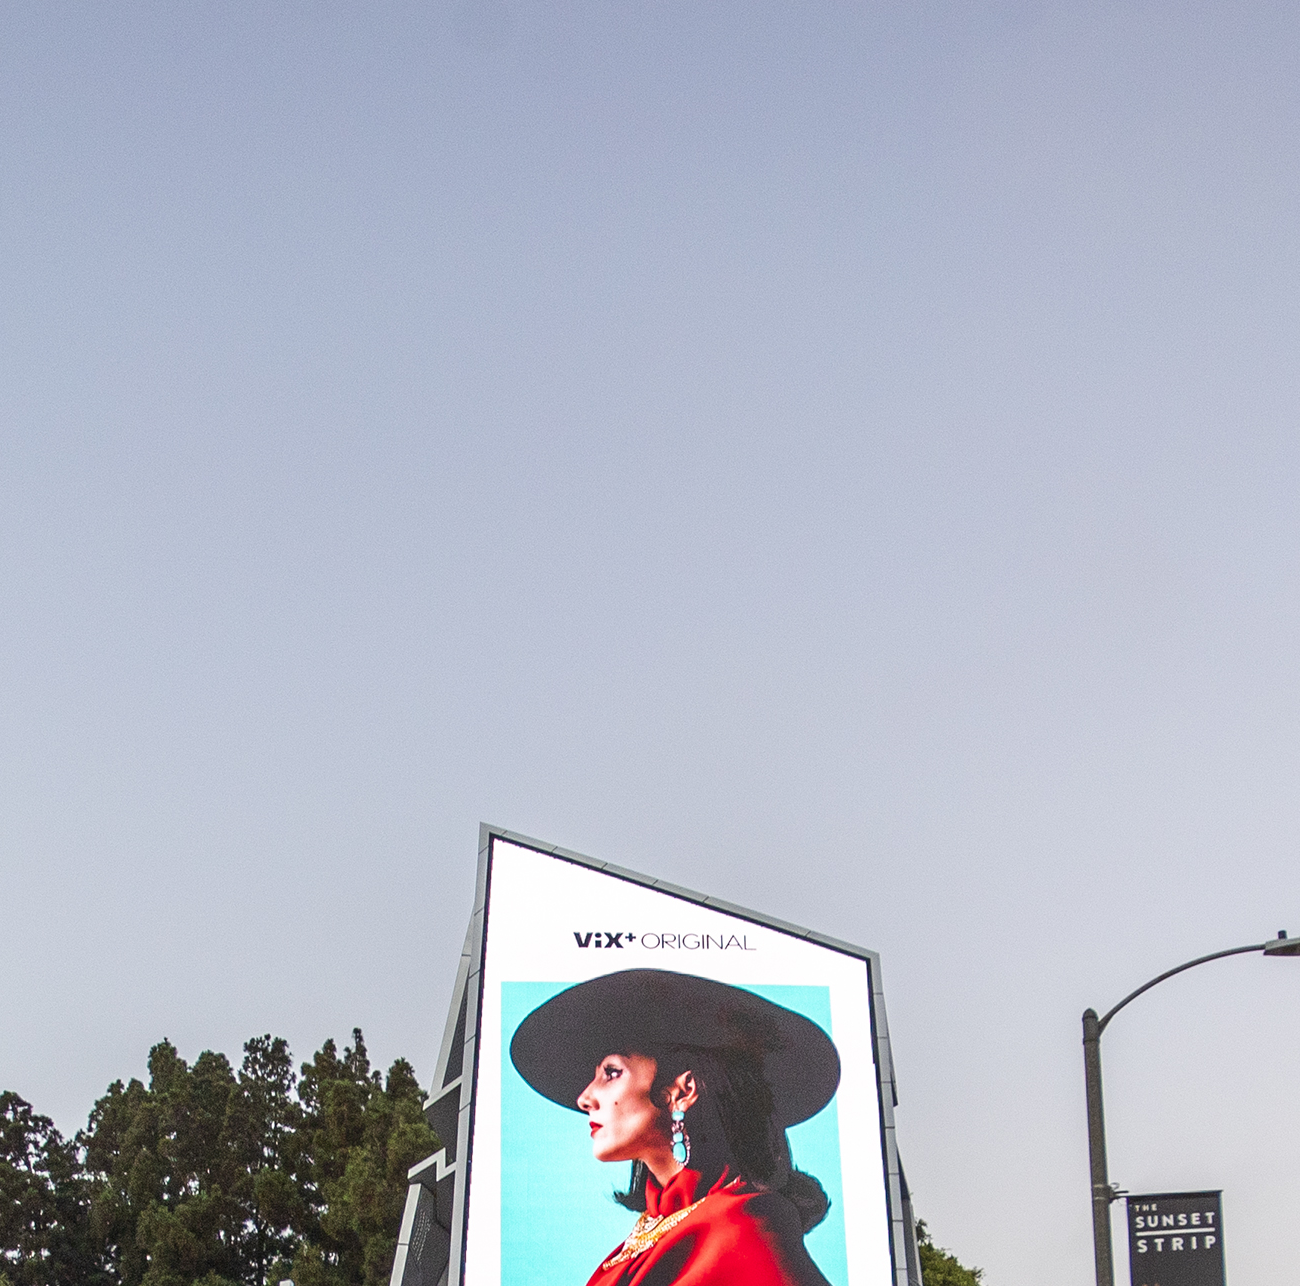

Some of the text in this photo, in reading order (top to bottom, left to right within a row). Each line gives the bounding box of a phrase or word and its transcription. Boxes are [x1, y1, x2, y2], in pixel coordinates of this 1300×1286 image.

[641, 933, 757, 950] ORIGINAL
[1135, 1204, 1157, 1212] THE
[1135, 1212, 1215, 1228] SUNSET
[1137, 1235, 1216, 1253] STRIP
